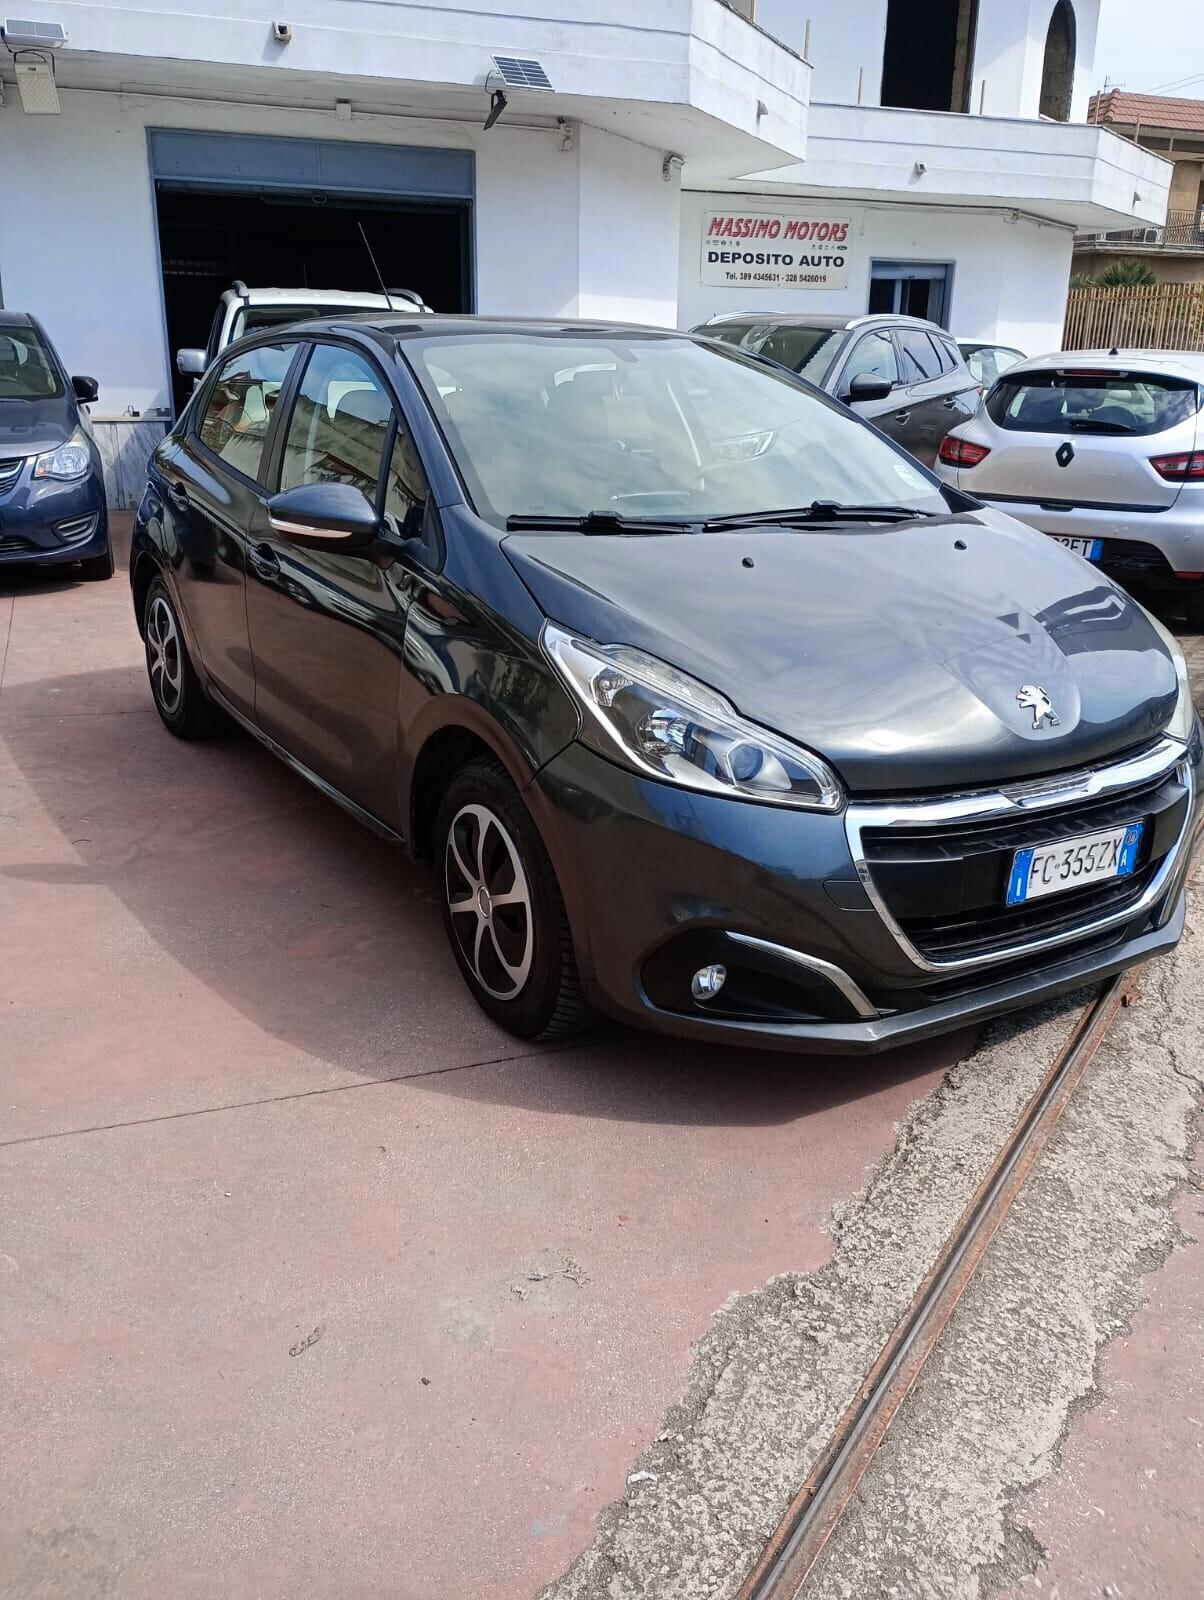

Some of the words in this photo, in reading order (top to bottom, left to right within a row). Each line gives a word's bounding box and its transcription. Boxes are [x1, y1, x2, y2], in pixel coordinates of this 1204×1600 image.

[708, 217, 781, 239] MASSIMO
[784, 221, 849, 241] MOTORS
[708, 251, 793, 266] DEPOSITO
[799, 255, 845, 267] AUTO
[726, 272, 737, 280] Tel.
[740, 272, 752, 280] 389
